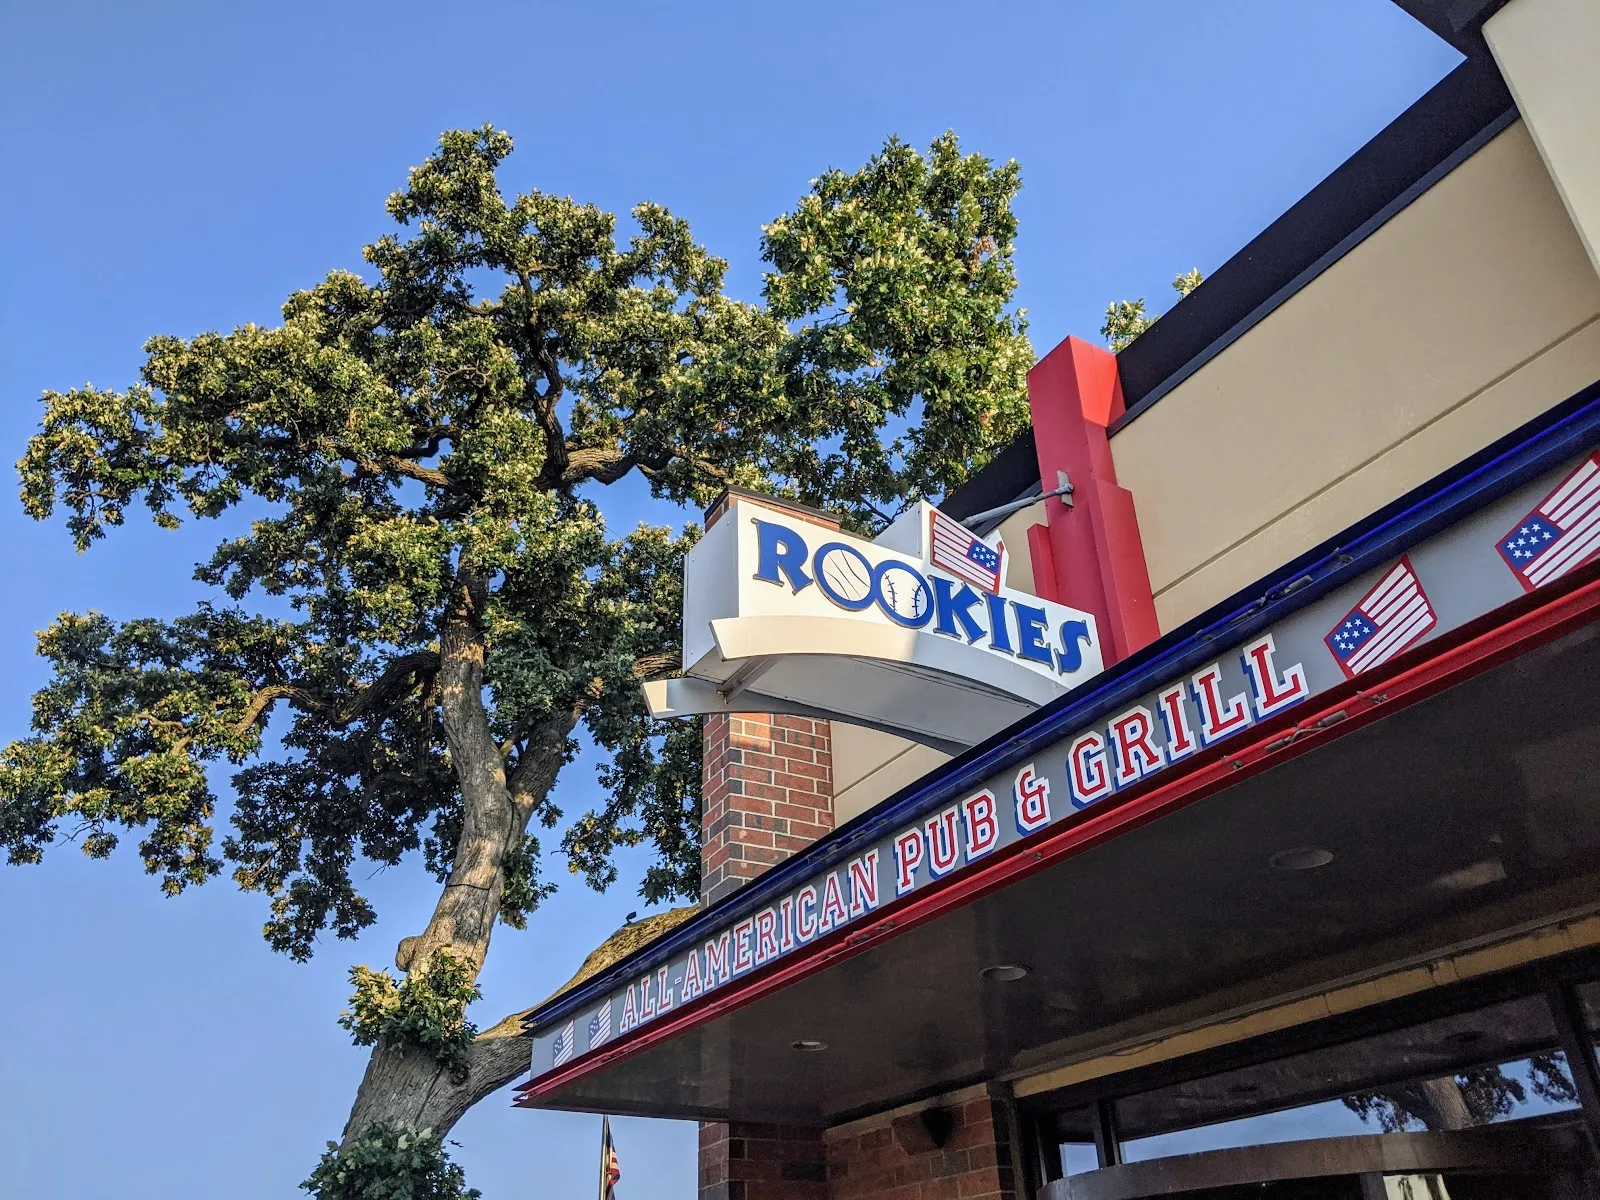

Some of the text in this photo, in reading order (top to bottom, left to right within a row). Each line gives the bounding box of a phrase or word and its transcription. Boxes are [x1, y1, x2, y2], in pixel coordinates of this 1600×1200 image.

[750, 517, 1092, 676] ROOKIES
[619, 632, 1310, 1034] ALL-AMERICAN PUB & GRILL
